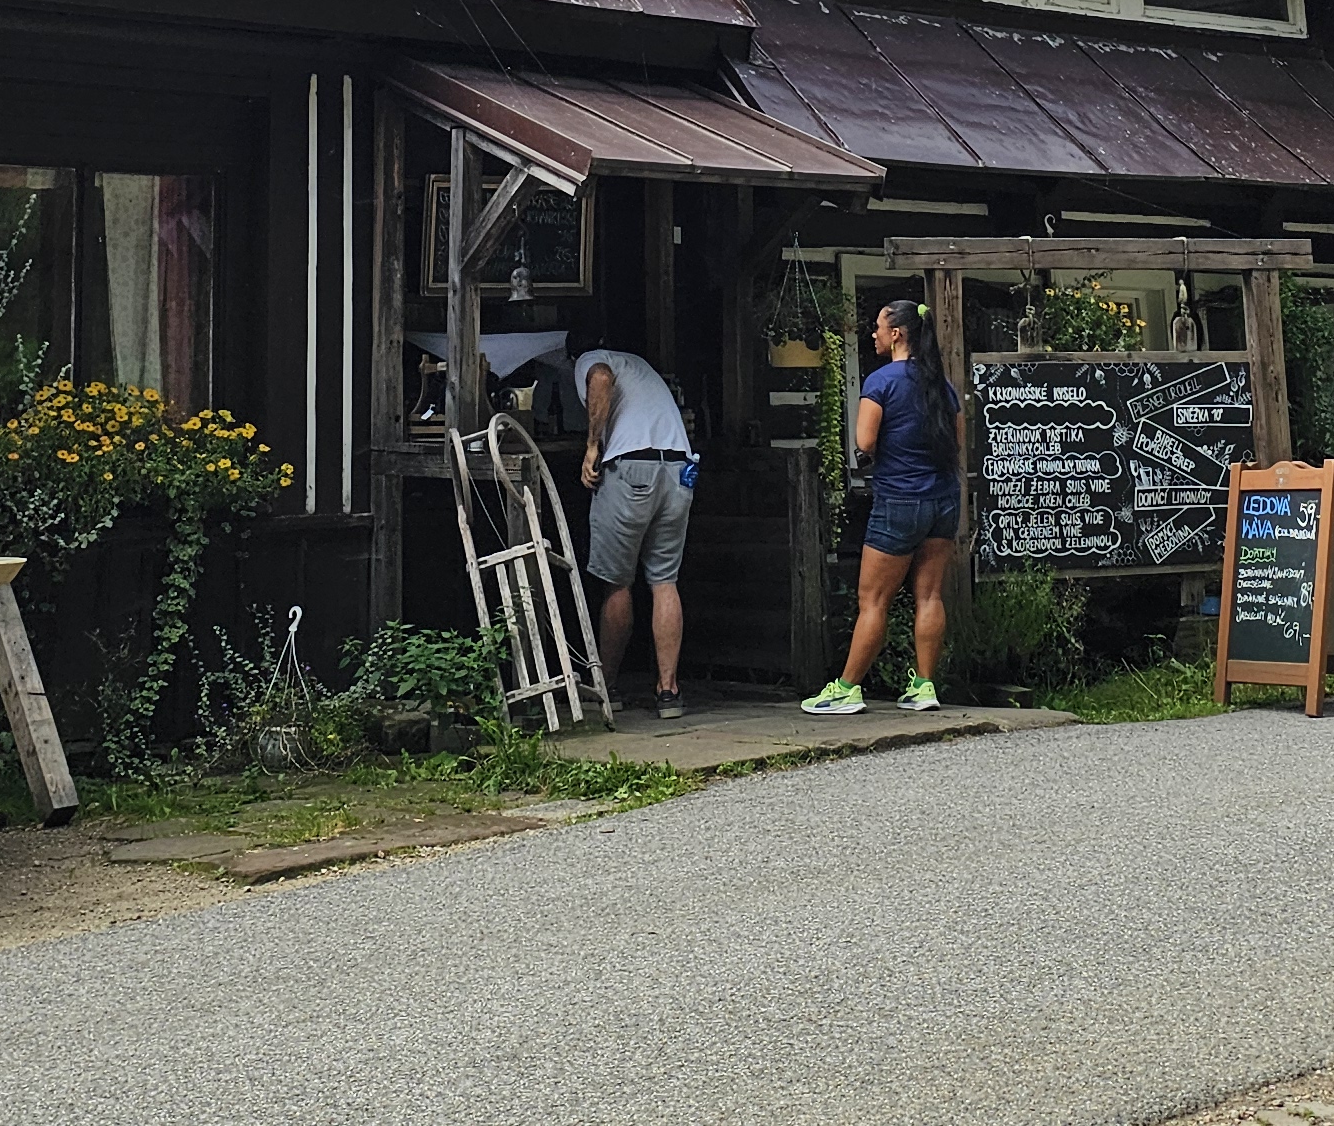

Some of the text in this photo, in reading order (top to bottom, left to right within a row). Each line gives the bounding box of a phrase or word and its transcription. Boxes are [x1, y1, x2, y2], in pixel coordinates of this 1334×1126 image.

[988, 383, 1086, 401] KRKONOŠSKÉ KYSELO
[1177, 407, 1209, 423] SNĚŽKA
[1154, 430, 1183, 455] BIRELL
[1137, 434, 1196, 472] POMELO-GREP
[989, 478, 1025, 495] HOVĚZÍ
[1030, 478, 1061, 494] ŽEBRA
[1089, 479, 1111, 493] VIDE
[1066, 492, 1090, 506] CHLÉB
[1138, 488, 1212, 506] DOMÁCÍ LIMONÁDY
[1243, 494, 1291, 516] LEDOVÁ
[1027, 514, 1055, 527] JELEN
[1084, 512, 1104, 524] VIDE
[1241, 517, 1275, 539] KÁVA
[1002, 528, 1015, 541] NA
[1019, 524, 1060, 538] ČERVENÉM
[1148, 520, 1177, 548] DOMÁCÍ
[1000, 535, 1112, 552] S KOŘENOVOU ZELENINOU
[1154, 525, 1193, 560] MEDOVINA
